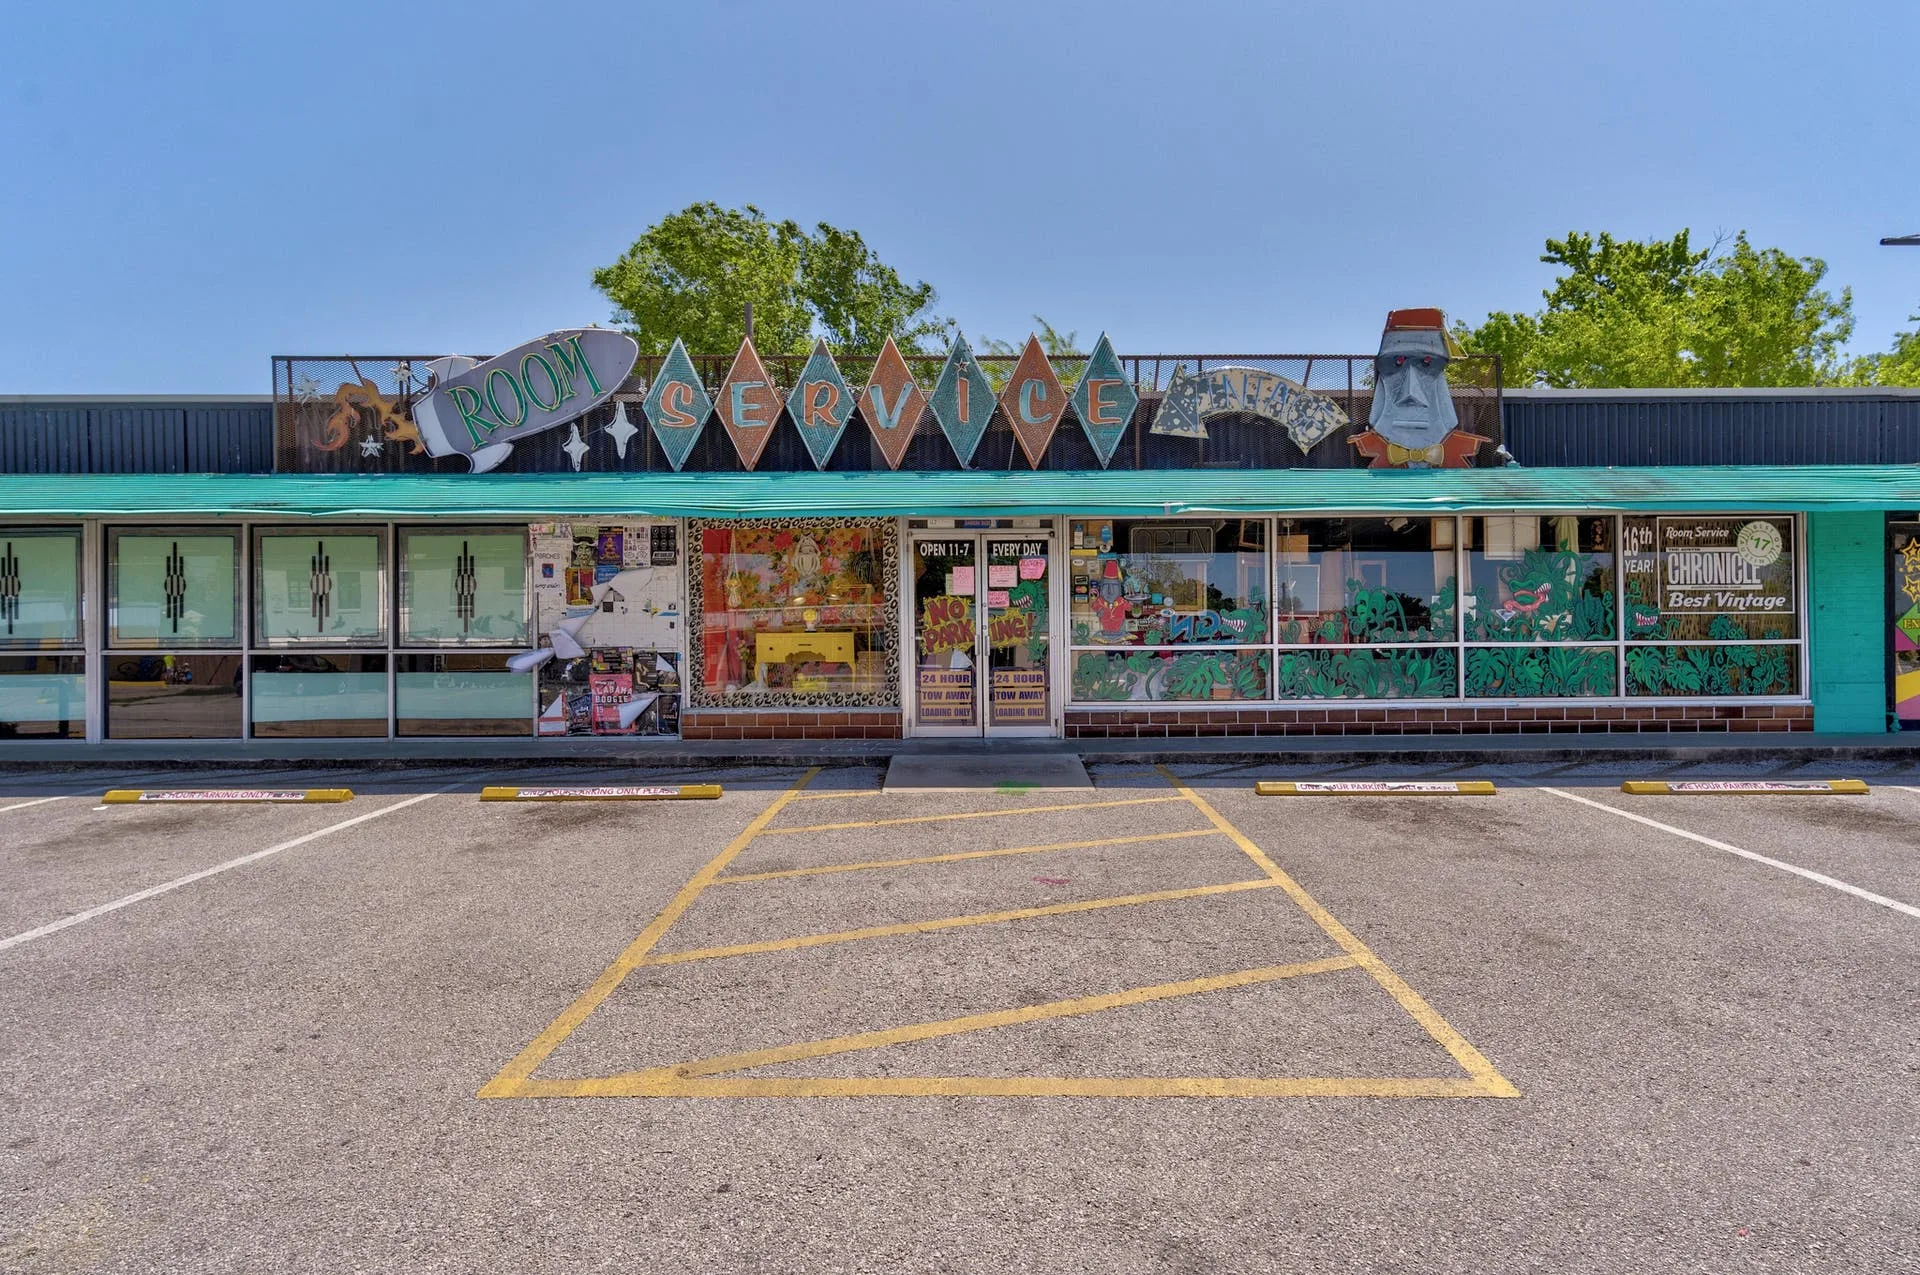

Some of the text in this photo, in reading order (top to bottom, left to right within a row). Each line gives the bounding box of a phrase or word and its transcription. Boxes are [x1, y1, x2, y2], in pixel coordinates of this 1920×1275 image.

[445, 333, 604, 449] ROOM
[657, 378, 1124, 430] SERVICE
[1665, 526, 1730, 540] Room Service
[1134, 529, 1211, 557] OPEN
[920, 543, 970, 557] OPEN 11-7
[992, 543, 1043, 556] EVERY DAY
[1624, 558, 1654, 573] YEAR!
[1667, 553, 1761, 585] CHRONICLE
[1668, 591, 1786, 610] Best Vintage
[927, 599, 966, 627] NO
[922, 674, 970, 684] 24 HOUR
[995, 674, 1043, 684] 24 HOUR
[595, 695, 629, 703] BOOGIE
[922, 690, 970, 701] TOW AWAY
[995, 690, 1044, 701] TOW AWAY
[921, 707, 971, 717] LOADING ONLY
[995, 707, 1044, 717] LOADING ONLY
[616, 787, 639, 795] ONLY
[1351, 783, 1390, 791] PARKIN
[1695, 782, 1721, 790] HOUR
[197, 791, 239, 799] PARKING
